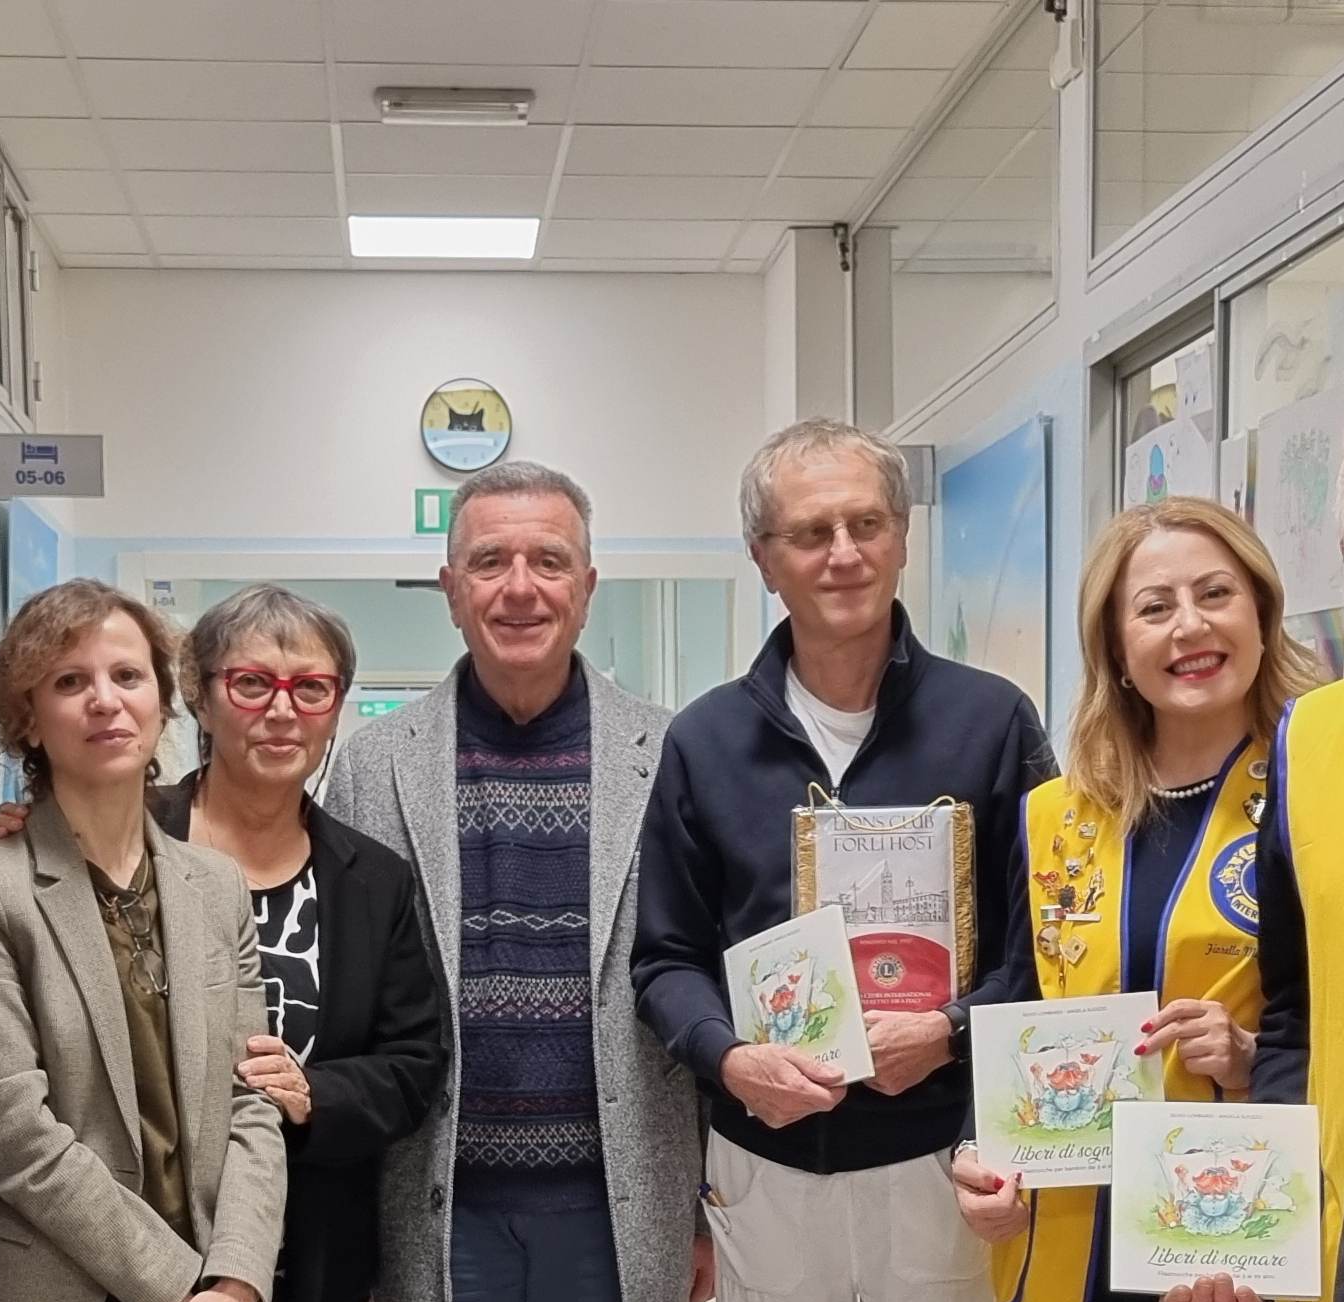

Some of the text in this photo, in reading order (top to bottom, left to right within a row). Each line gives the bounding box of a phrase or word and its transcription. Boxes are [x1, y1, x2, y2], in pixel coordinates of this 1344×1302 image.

[16, 470, 65, 485] 05-06
[833, 814, 935, 831] LIONS CLUB
[891, 835, 935, 850] HOST
[1011, 1144, 1056, 1164] Liberi
[1059, 1143, 1075, 1161] di
[1148, 1245, 1289, 1273] Liberi di sognare
